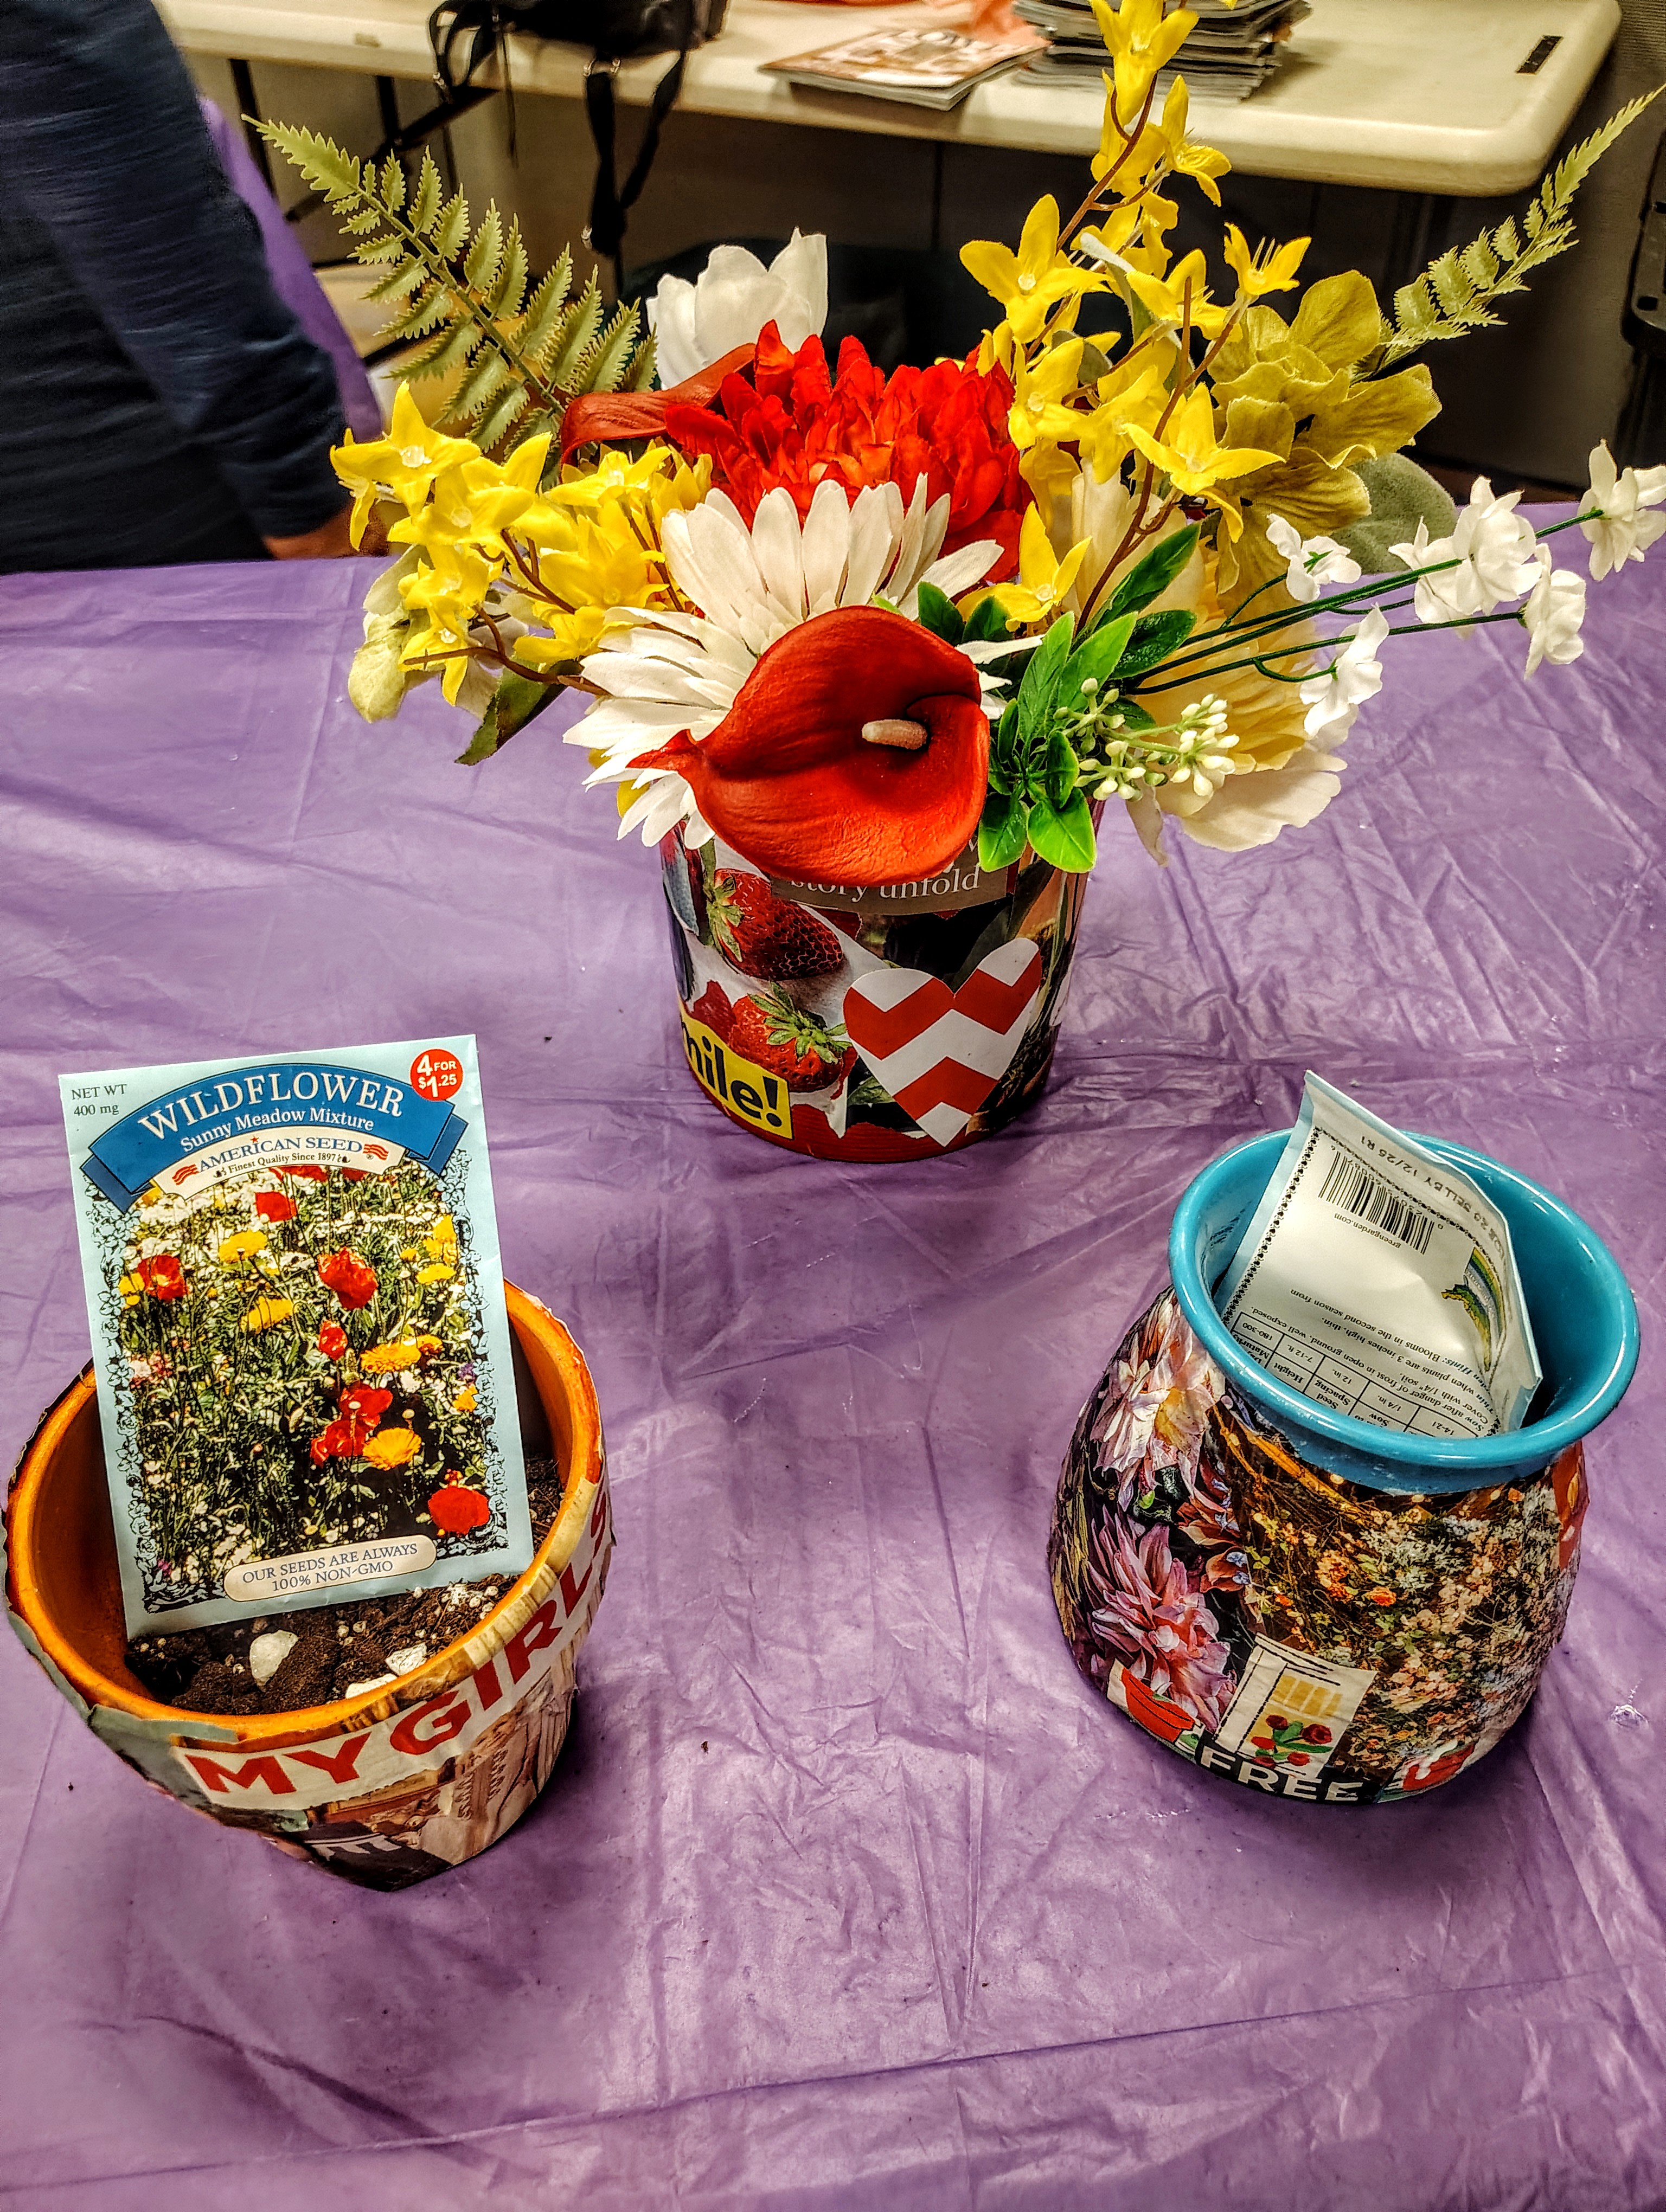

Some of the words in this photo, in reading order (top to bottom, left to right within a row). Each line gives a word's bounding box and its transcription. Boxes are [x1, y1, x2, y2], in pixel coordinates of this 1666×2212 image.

[879, 863, 980, 899] unfold
[416, 1054, 433, 1076] 4
[434, 1060, 457, 1072] FOR
[72, 1086, 100, 1100] NET
[104, 1084, 127, 1095] WT
[418, 1073, 457, 1097] $1.25
[74, 1104, 95, 1116] 400
[100, 1104, 119, 1115] mg
[138, 1072, 403, 1140] WILDFLOWER
[180, 1123, 232, 1152] Sunny
[236, 1109, 305, 1131] Meadow
[310, 1107, 374, 1131] Mixture
[198, 1137, 301, 1172] AMERICAN
[306, 1137, 362, 1153] SEED
[229, 1162, 256, 1174] Finest
[258, 1155, 289, 1167] Quality
[292, 1153, 315, 1161] Since
[318, 1153, 335, 1162] 1897
[1334, 1213, 1401, 1249] greengarden.com
[1290, 1289, 1312, 1303] from
[1314, 1300, 1343, 1316] season
[1251, 1307, 1287, 1327] exposed.
[1322, 1317, 1341, 1330] thin.
[1343, 1315, 1376, 1332] second
[1242, 1322, 1273, 1340] 180-300
[1287, 1326, 1306, 1338] well
[1343, 1327, 1366, 1343] high,
[1377, 1329, 1392, 1340] the
[1367, 1340, 1396, 1359] inches
[1394, 1337, 1404, 1346] in
[1295, 1349, 1313, 1363] 7-12
[1405, 1342, 1440, 1362] Blooms
[1343, 1354, 1364, 1368] open
[1405, 1360, 1420, 1369] are
[1442, 1358, 1473, 1375] Hints:
[1274, 1362, 1304, 1384] Height
[1366, 1366, 1375, 1375] in
[1421, 1367, 1451, 1380] plants
[1342, 1375, 1352, 1384] 12
[1376, 1372, 1398, 1387] frost
[1400, 1373, 1419, 1386] soil.
[1451, 1378, 1474, 1394] when
[1315, 1379, 1353, 1405] Spacing
[1409, 1391, 1441, 1406] danger
[1441, 1391, 1460, 1404] with
[1316, 1393, 1338, 1410] Seed
[1476, 1394, 1495, 1414] Thin
[1441, 1404, 1464, 1417] after
[1462, 1404, 1488, 1424] Cover
[1369, 1413, 1390, 1426] Sow
[1465, 1417, 1484, 1431] Sow
[1432, 1422, 1454, 1436] 14-21
[242, 1567, 278, 1584] OUR
[280, 1558, 326, 1576] SEEDS
[330, 1551, 359, 1568] ARE
[362, 1544, 418, 1561] ALWAYS
[272, 1574, 311, 1592] 100%
[316, 1560, 393, 1584] NON-GMO
[185, 1731, 373, 1795] MY
[389, 1476, 606, 1756] GIRLS
[1200, 1745, 1364, 1802] FREE
